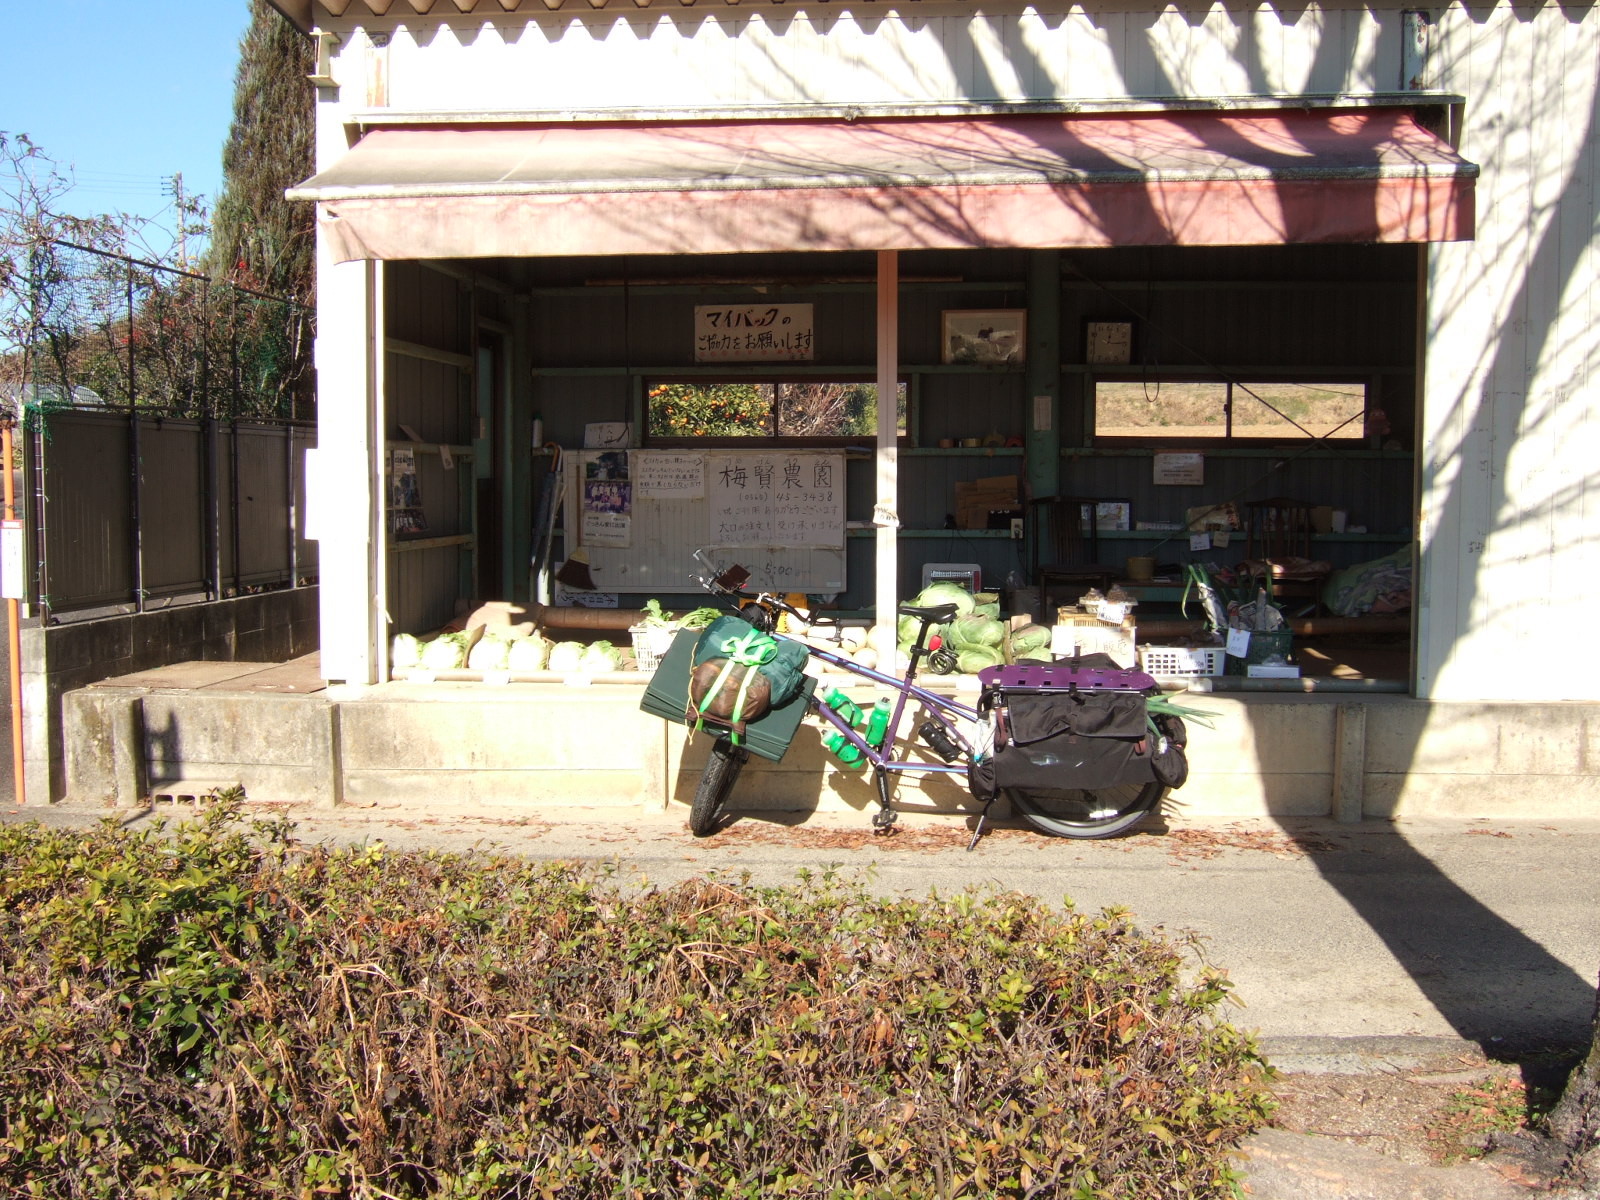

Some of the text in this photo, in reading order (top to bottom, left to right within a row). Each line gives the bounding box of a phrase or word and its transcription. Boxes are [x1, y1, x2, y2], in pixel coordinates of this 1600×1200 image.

[706, 308, 792, 328] マイバックの
[698, 328, 814, 351] ご協力をお願いします
[718, 464, 832, 489] 梅賢農園
